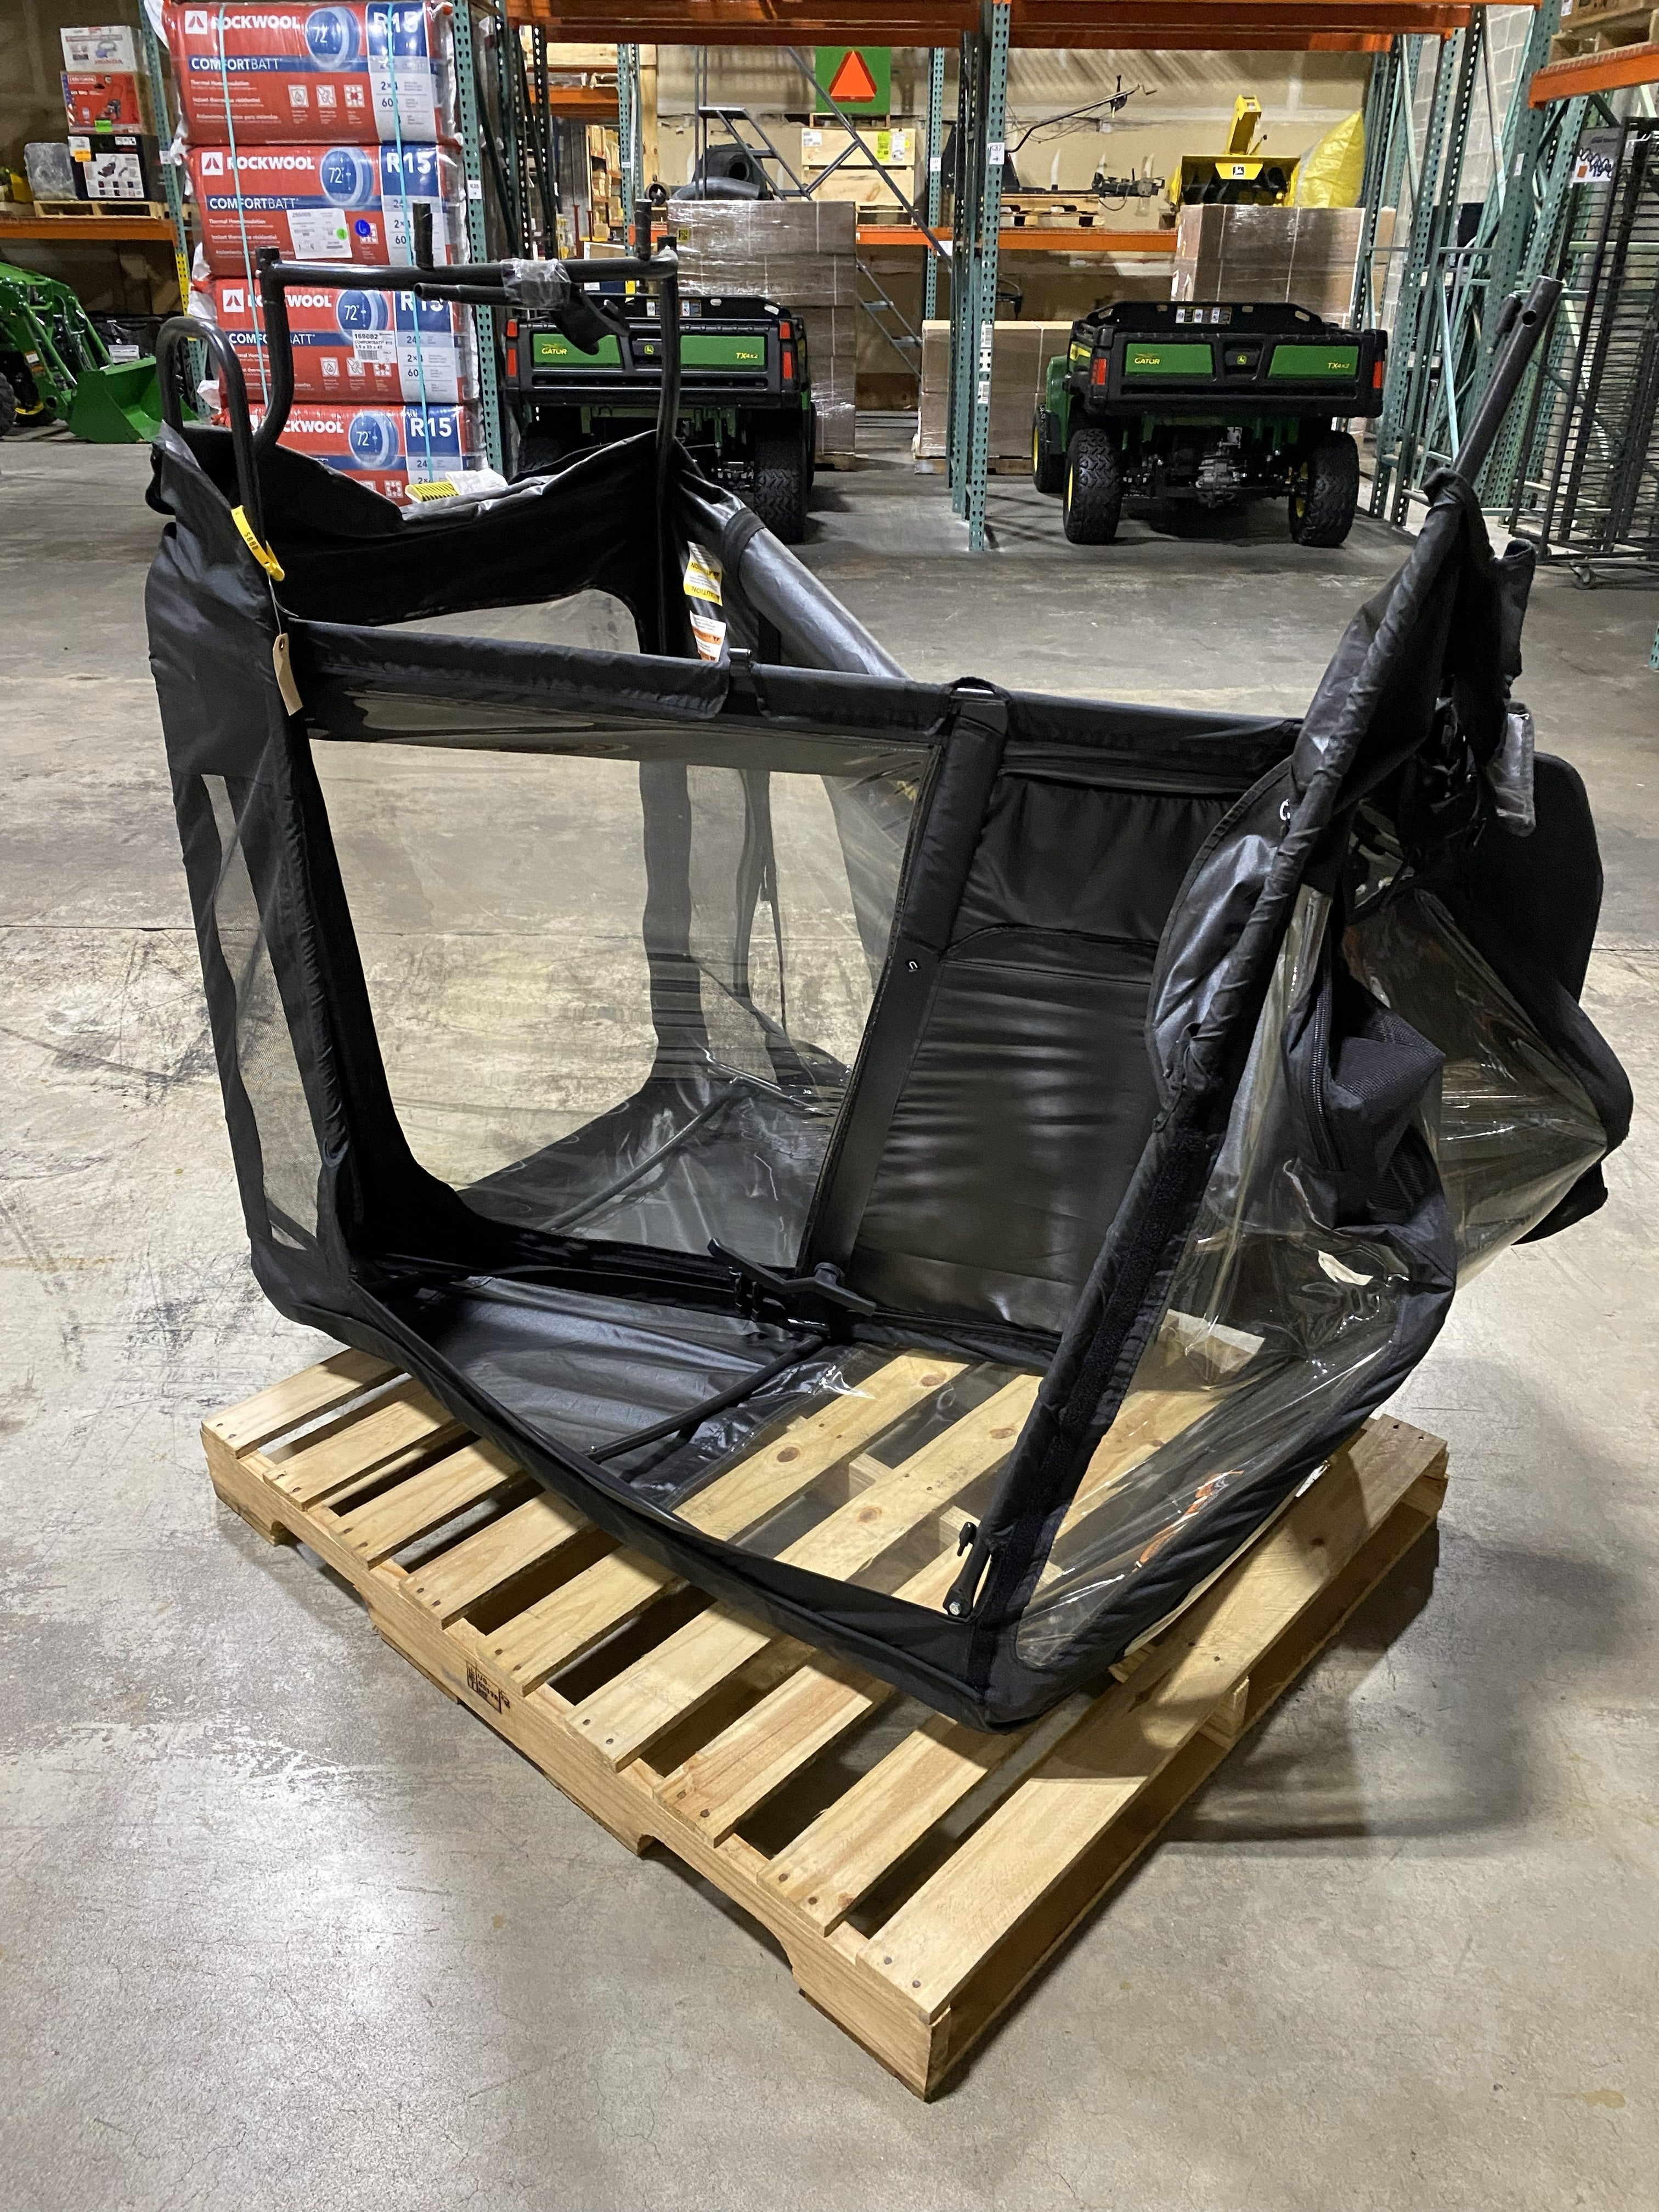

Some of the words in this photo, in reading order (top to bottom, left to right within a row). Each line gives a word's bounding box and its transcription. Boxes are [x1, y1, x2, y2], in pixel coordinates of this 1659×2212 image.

[211, 15, 300, 30] ROCKWOOL
[374, 12, 419, 35] R15
[192, 58, 279, 70] COMORTBATT
[227, 156, 315, 170] ROCKWOOL
[386, 152, 431, 173] R15
[247, 294, 332, 308] OWOOL
[283, 420, 344, 433] CKWOOL
[411, 417, 452, 437] R15
